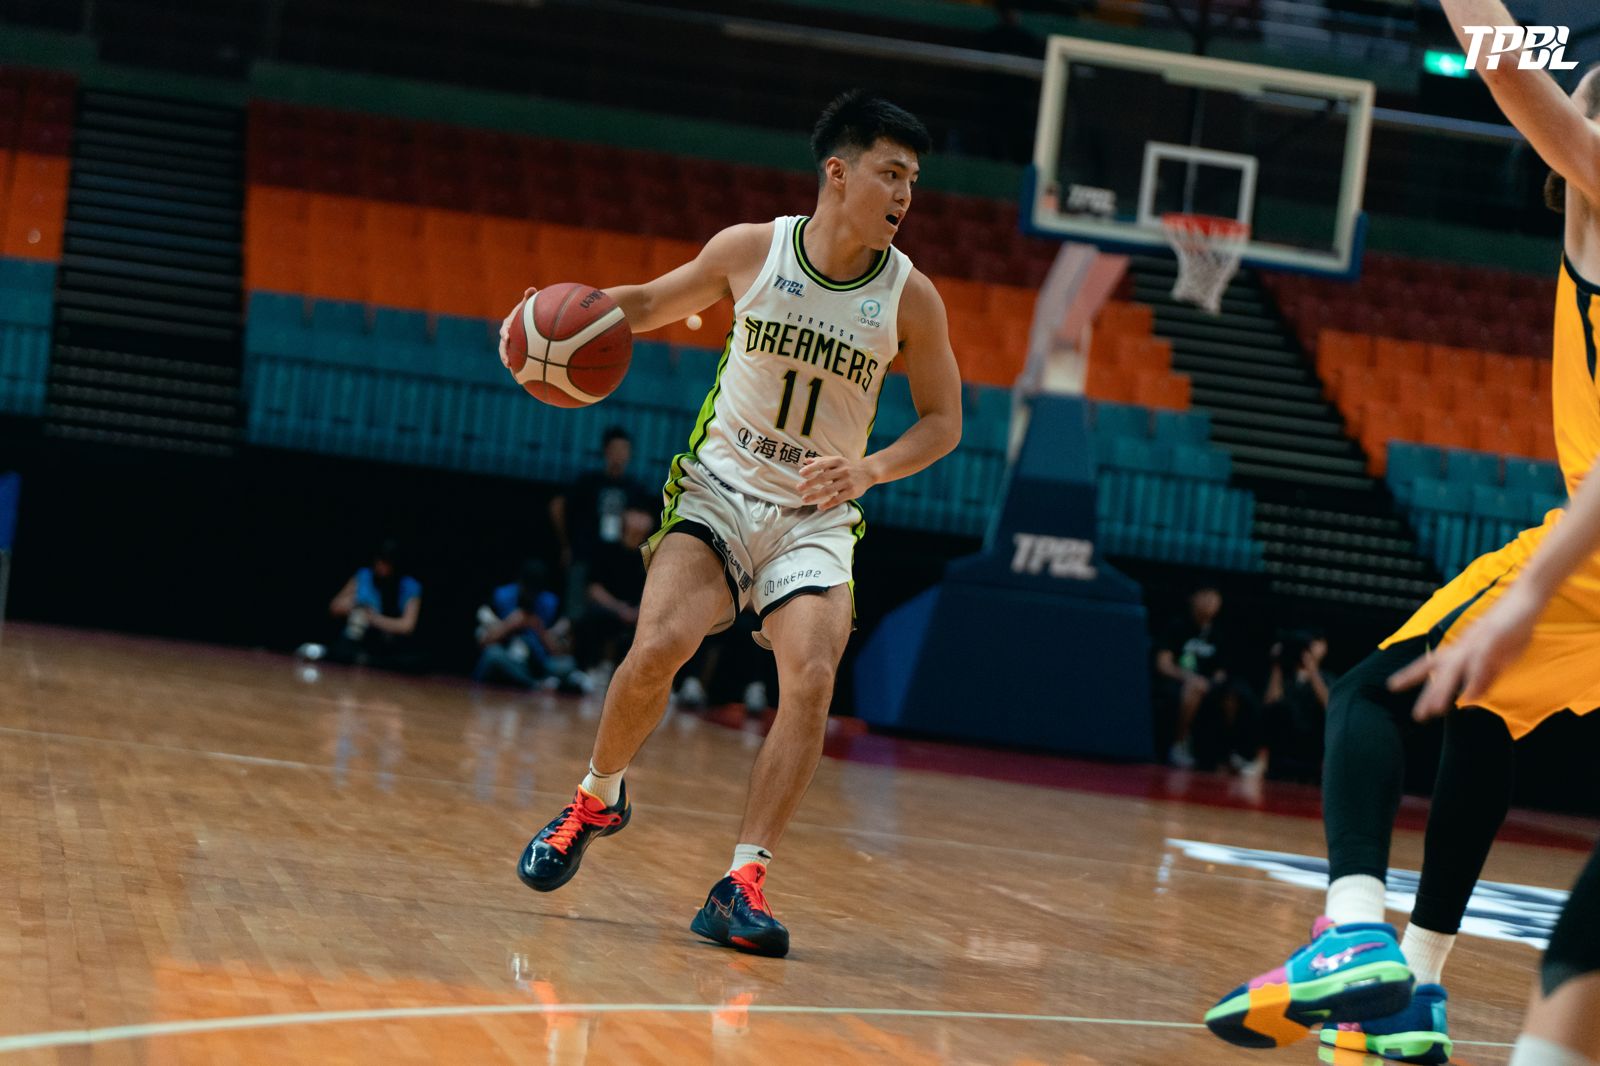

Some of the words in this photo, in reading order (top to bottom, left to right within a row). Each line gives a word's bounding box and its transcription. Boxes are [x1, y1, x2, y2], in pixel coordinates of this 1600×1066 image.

[773, 275, 805, 298] TPBL
[786, 312, 854, 342] FORMOSA
[745, 316, 879, 393] DREAMERS
[775, 369, 823, 437] 11
[1011, 532, 1098, 579] TPBL
